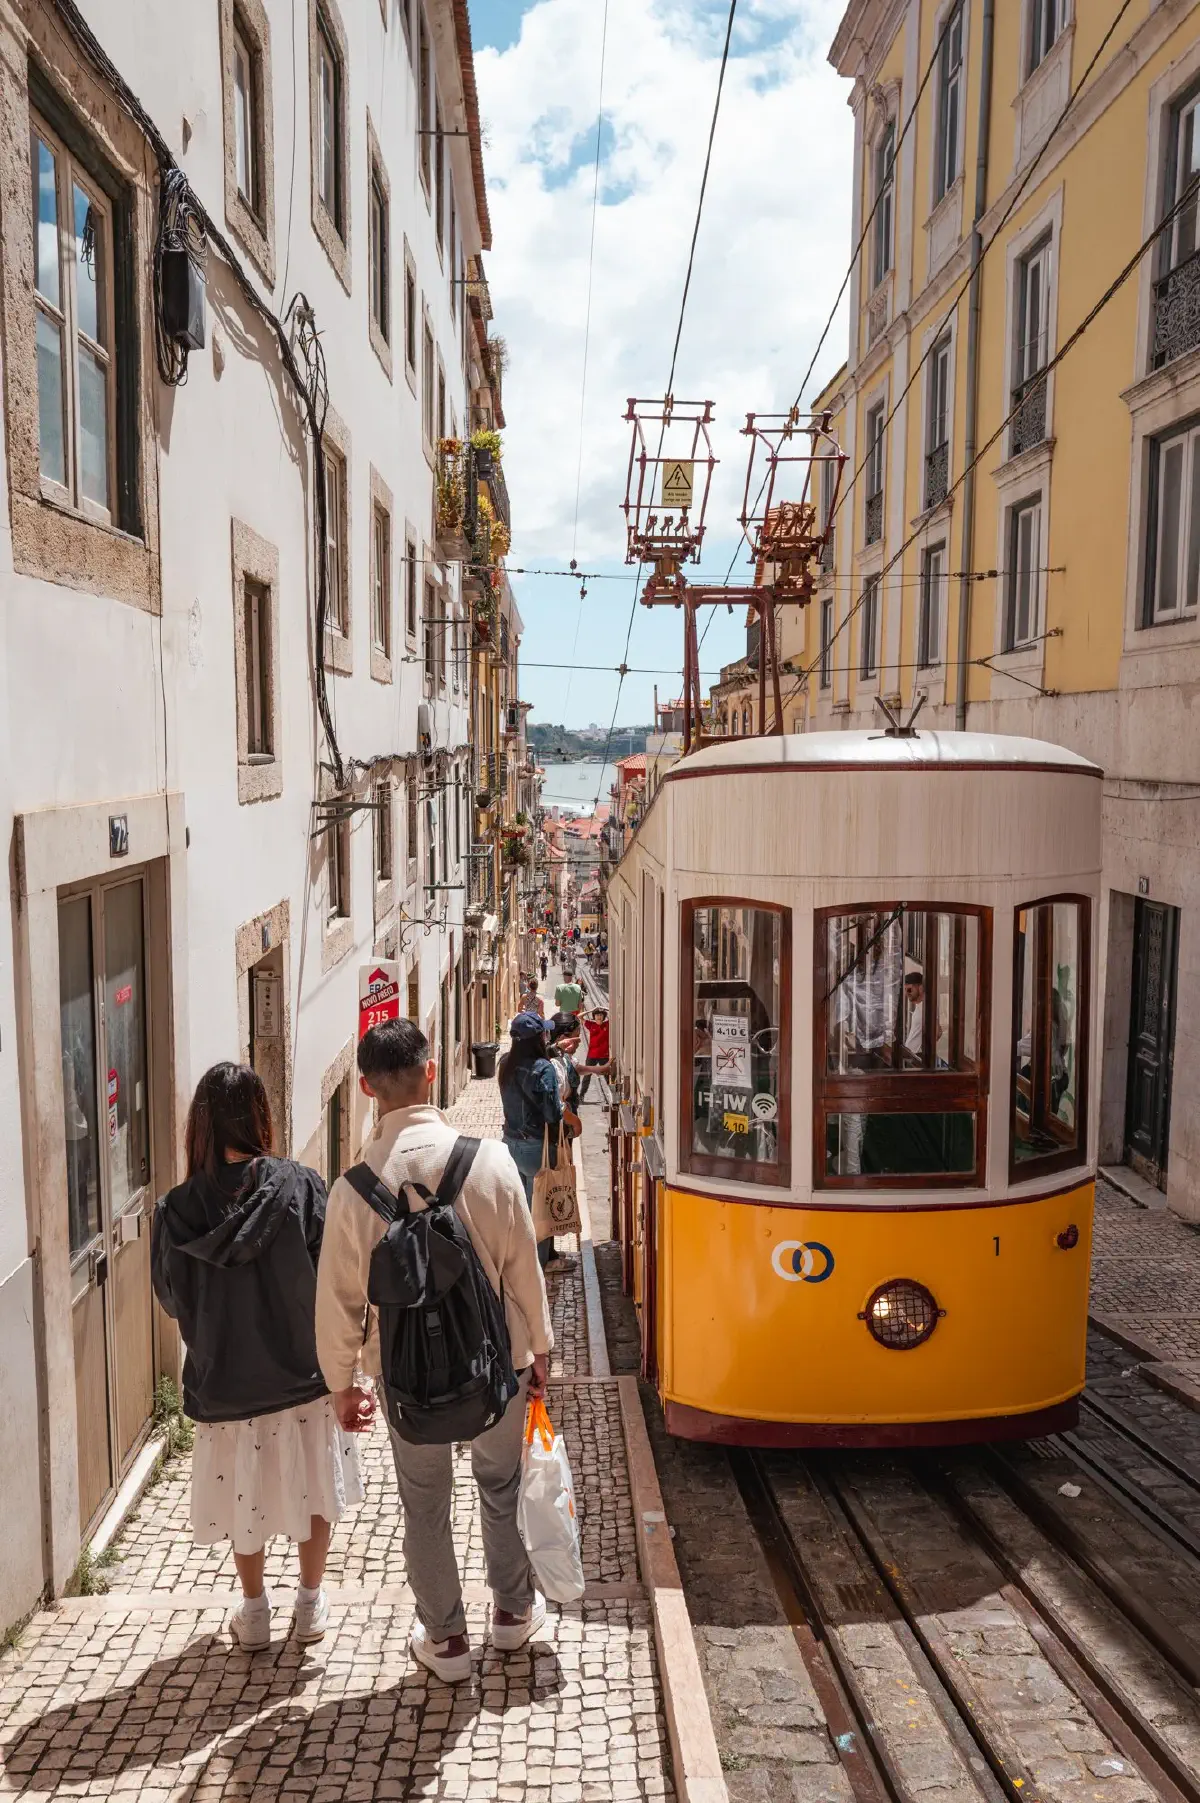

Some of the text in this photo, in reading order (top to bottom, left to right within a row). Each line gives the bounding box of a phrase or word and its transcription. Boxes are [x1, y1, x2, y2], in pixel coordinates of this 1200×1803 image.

[369, 983, 387, 994] ER
[361, 985, 394, 1009] NOVO PREÇO
[367, 1009, 389, 1023] 215
[716, 1027, 747, 1037] 4.10 €
[992, 1236, 1000, 1257] 1
